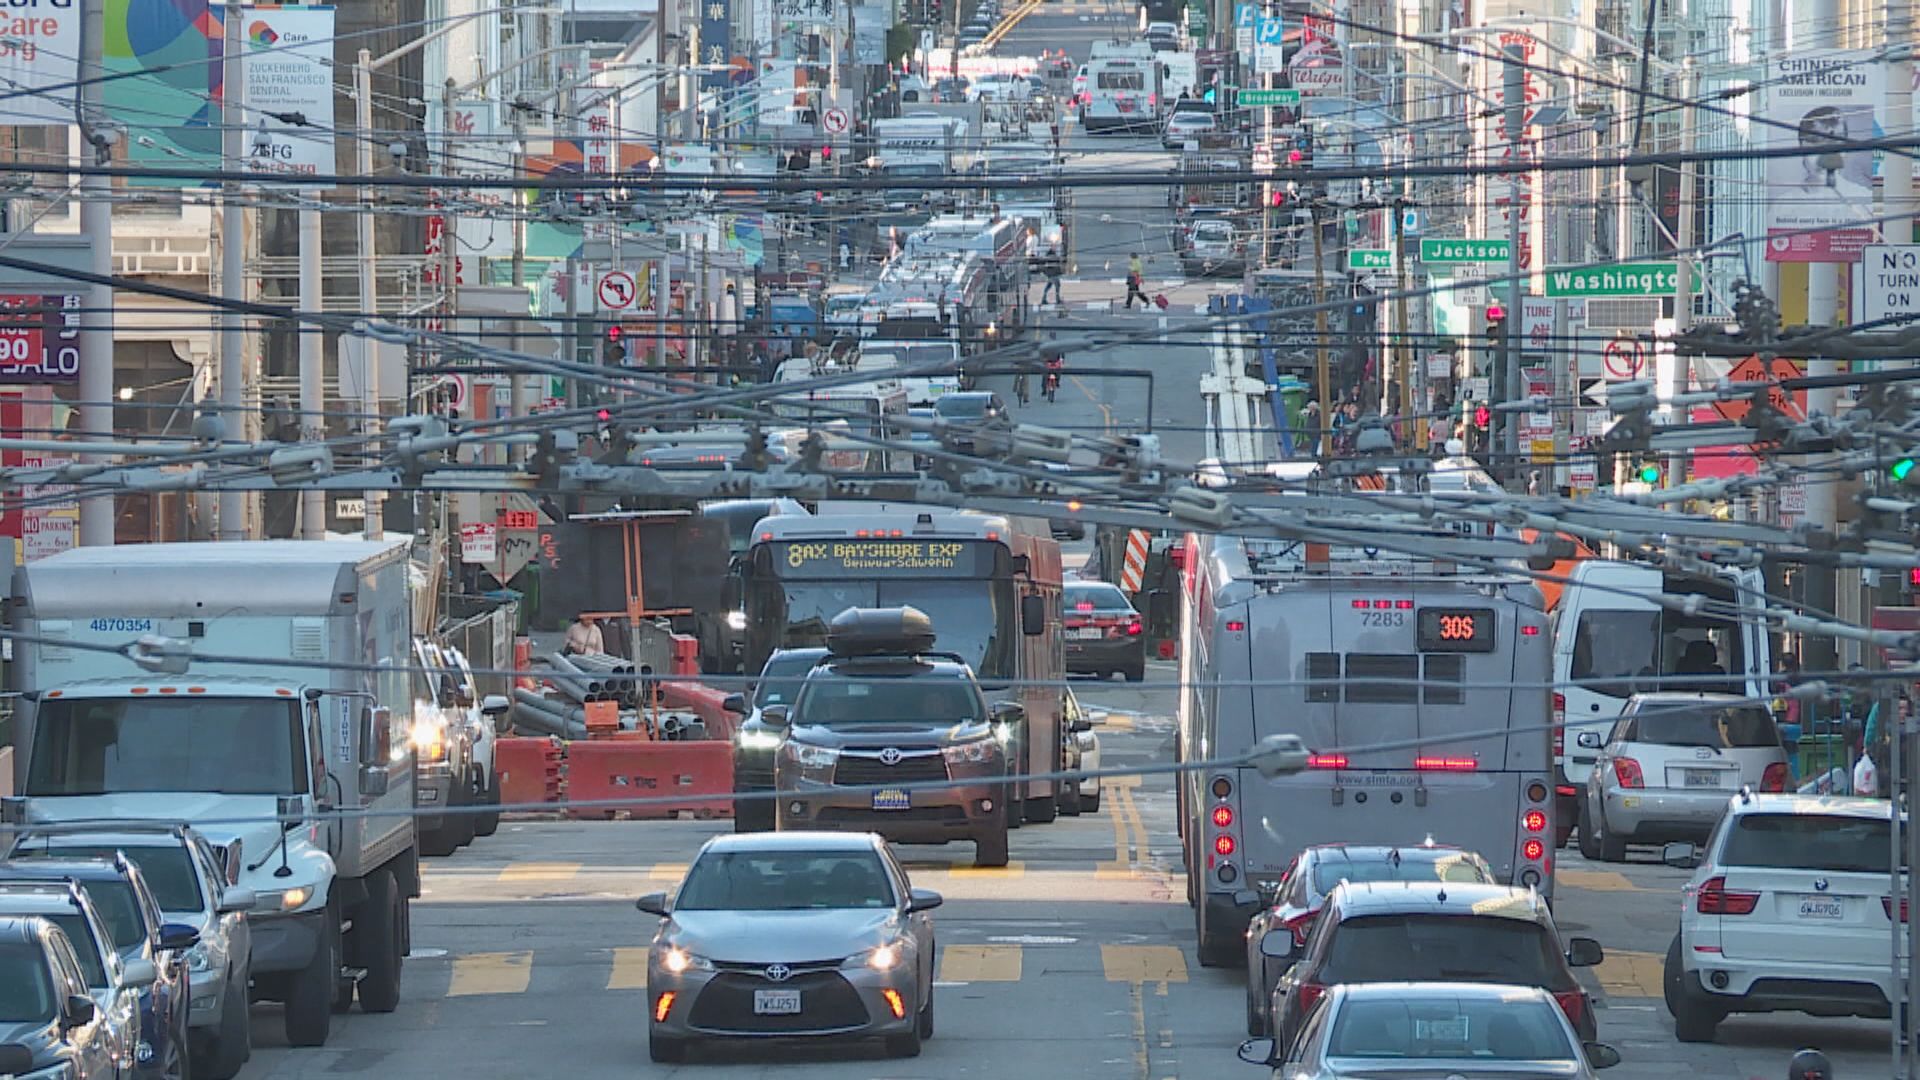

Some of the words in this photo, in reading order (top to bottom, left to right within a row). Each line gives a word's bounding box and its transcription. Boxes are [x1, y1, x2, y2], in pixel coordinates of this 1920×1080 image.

[1779, 60, 1854, 71] CHINESE
[249, 74, 269, 84] SAN
[271, 74, 326, 86] FRANCISCO
[1781, 74, 1867, 86] AMERICAN
[249, 86, 292, 96] GENERAL
[1432, 244, 1509, 258] Jackson
[1883, 252, 1916, 269] NO
[1878, 274, 1918, 288] TURN
[1888, 293, 1910, 307] ON
[25, 518, 38, 532] NO
[41, 522, 72, 531] PARKING
[833, 543, 924, 558] BAYSHORE
[928, 543, 963, 558] EXP
[90, 619, 152, 633] 4870354
[1361, 613, 1404, 627] 7283
[1440, 616, 1473, 640] 30S
